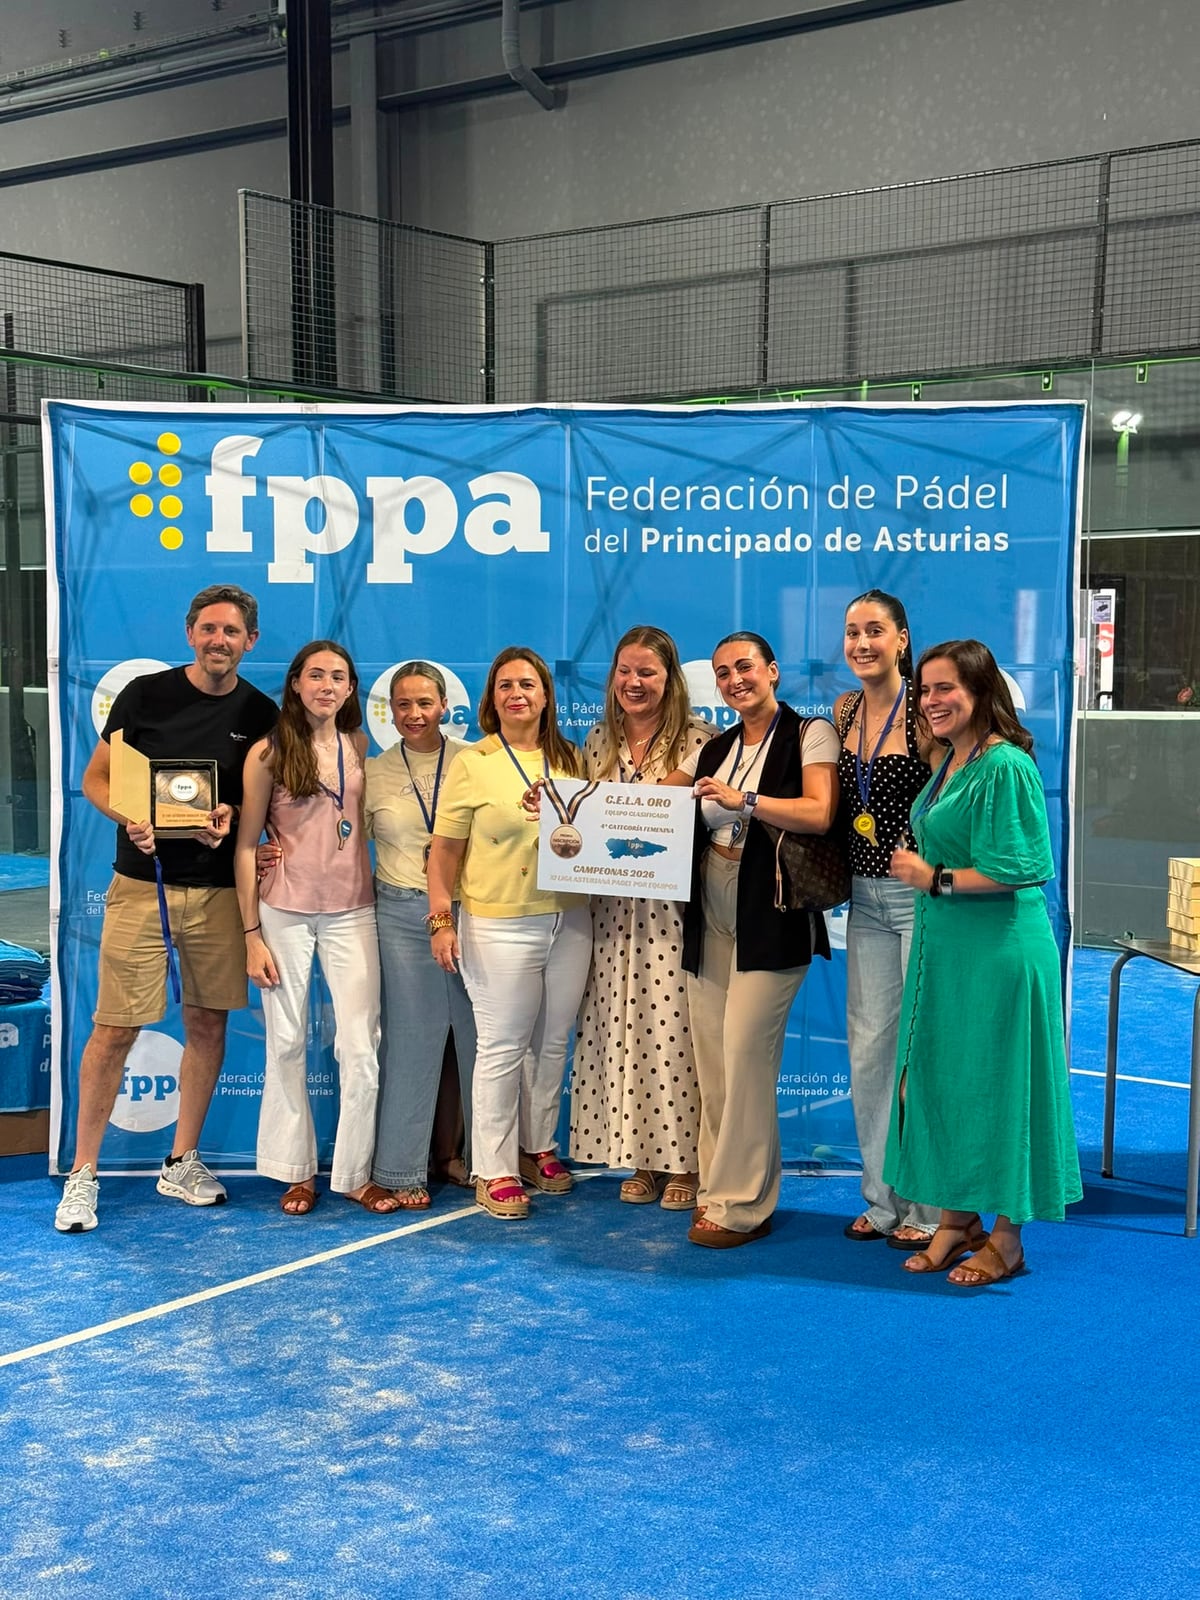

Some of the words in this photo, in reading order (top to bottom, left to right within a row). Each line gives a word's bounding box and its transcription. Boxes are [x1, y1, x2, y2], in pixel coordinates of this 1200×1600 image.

[586, 475, 809, 511] Federación
[827, 475, 876, 510] de
[896, 473, 1008, 510] Pádel
[205, 435, 550, 583] fppa
[584, 528, 628, 553] del
[641, 527, 812, 559] Principado
[825, 525, 862, 552] de
[873, 525, 1009, 552] Asturias
[794, 704, 834, 715] ración
[566, 718, 601, 727] Asturi
[605, 794, 644, 806] C.E.L.A.
[647, 797, 672, 808] ORO
[629, 811, 670, 819] CLASIFICADO
[573, 865, 629, 877] CAMPEONAS
[630, 869, 655, 879] 2026
[87, 905, 101, 915] del
[218, 1072, 265, 1084] deració
[307, 1072, 334, 1083] ádel
[776, 1072, 828, 1084] eración
[832, 1072, 848, 1084] de
[221, 1087, 264, 1097] Principa
[306, 1086, 334, 1096] urias
[776, 1087, 829, 1098] Principado
[832, 1087, 844, 1096] de
